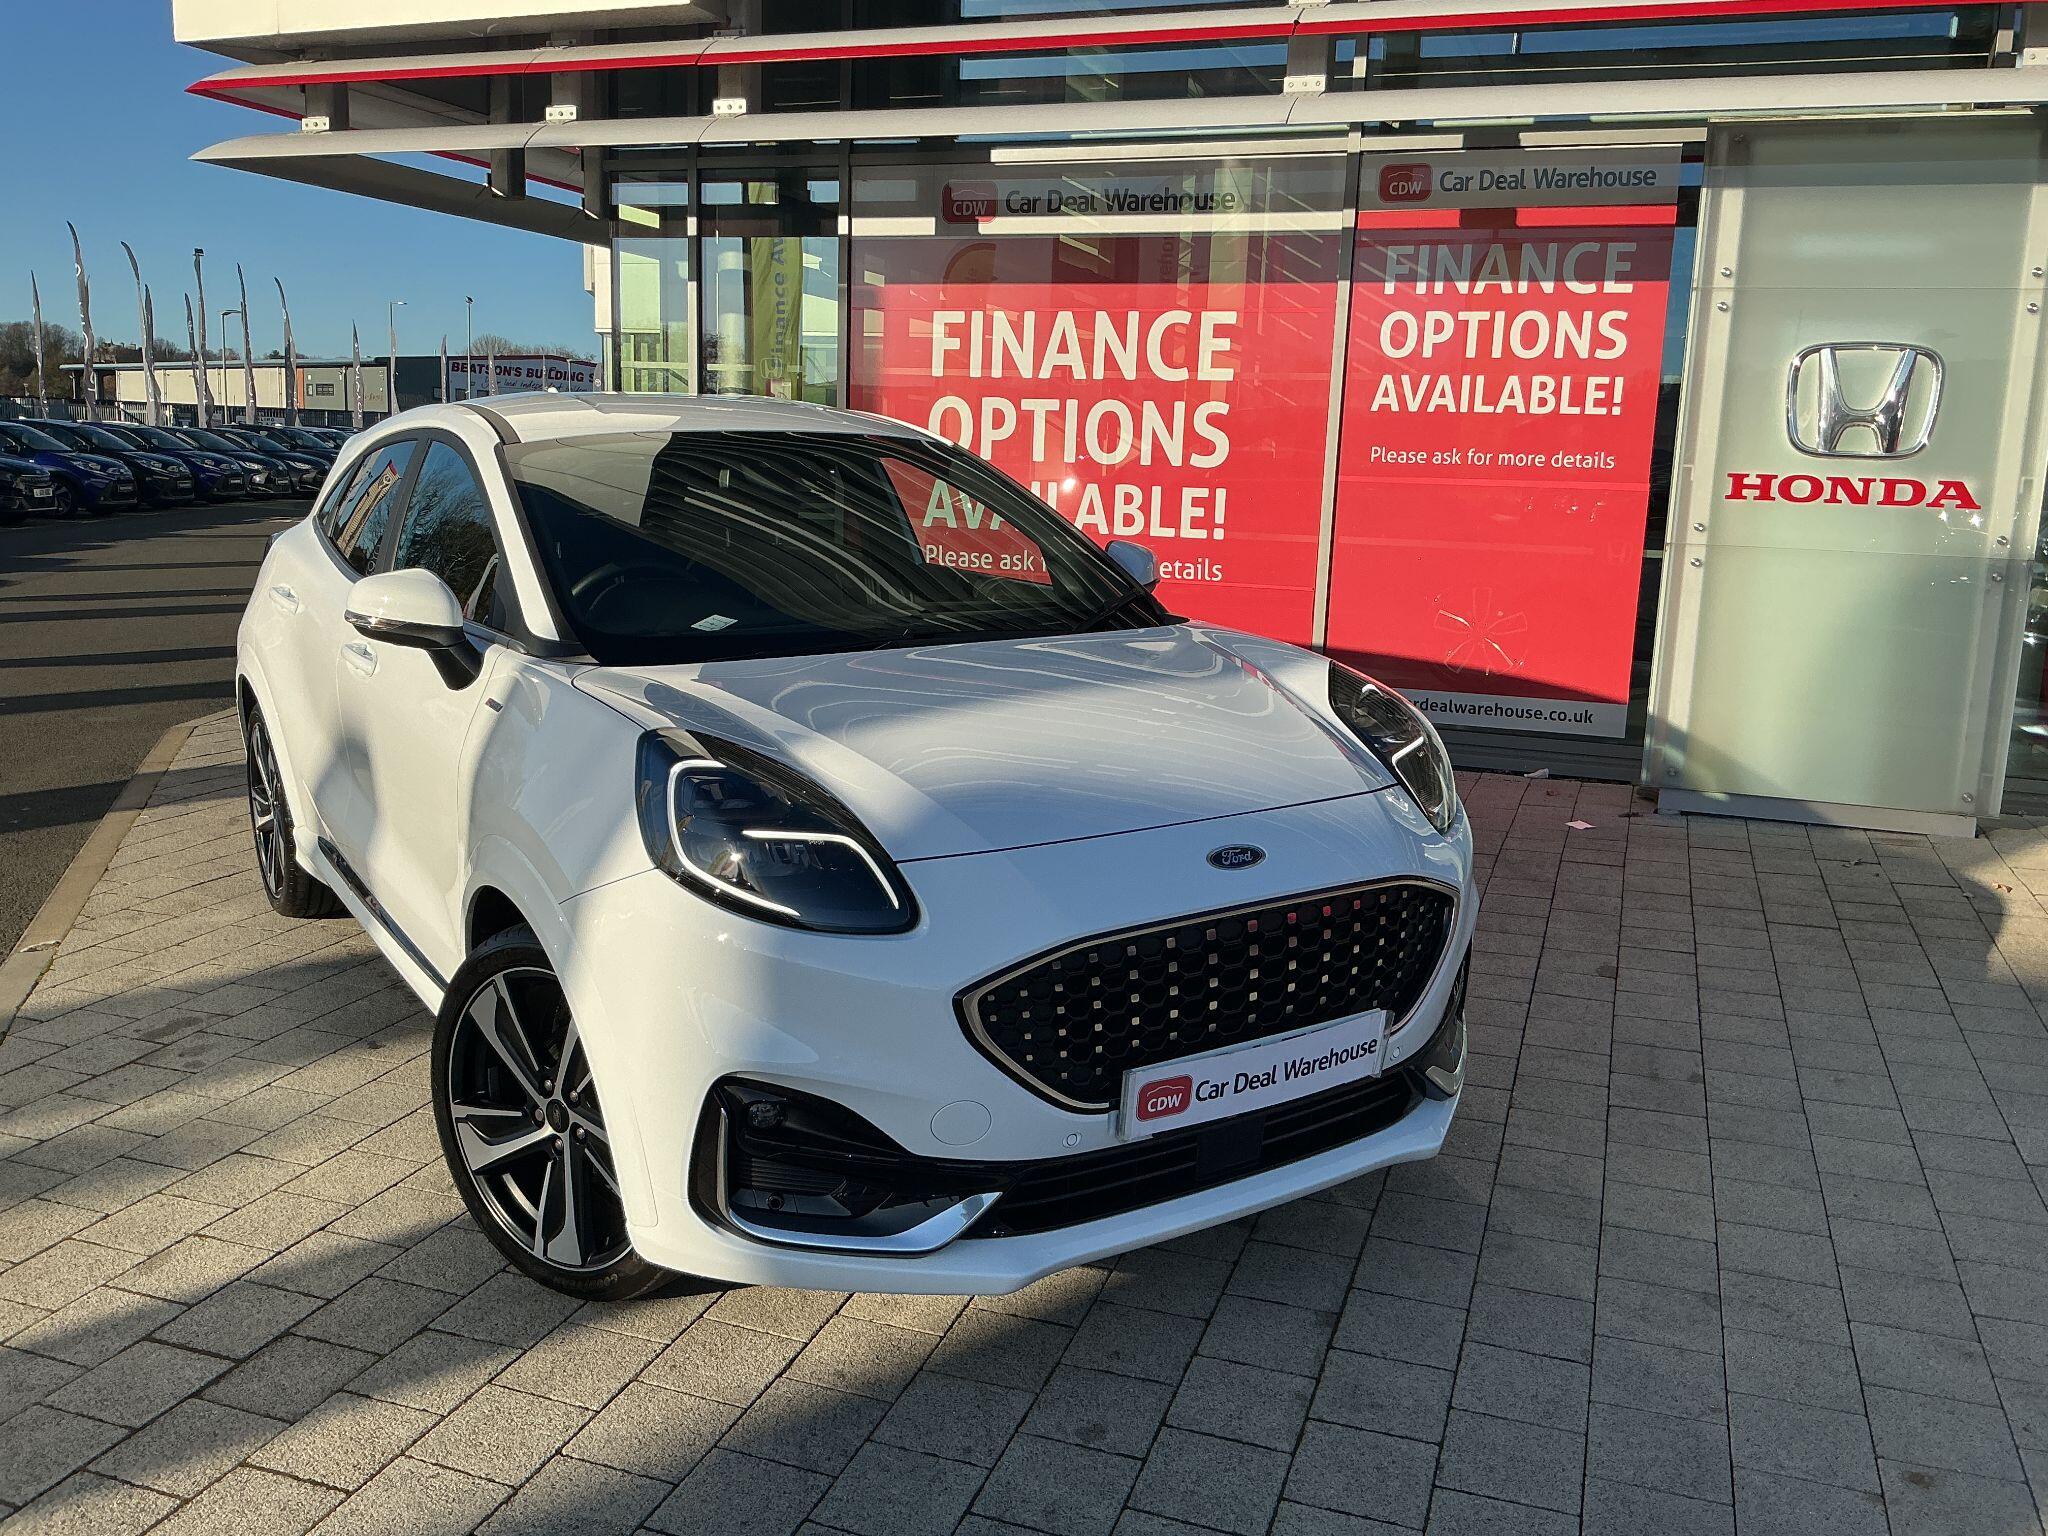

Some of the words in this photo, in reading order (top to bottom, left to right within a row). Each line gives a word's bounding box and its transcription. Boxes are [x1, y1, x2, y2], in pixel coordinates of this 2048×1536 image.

[952, 200, 988, 216] CDW
[1006, 190, 1039, 214] Car
[1046, 188, 1098, 213] Deal
[1103, 186, 1236, 213] Warehouse
[1389, 180, 1422, 196] CDW
[1440, 170, 1474, 193] Car
[1478, 168, 1527, 192] Deal
[1533, 166, 1657, 190] Warehouse
[1383, 241, 1637, 295] FINANCE
[931, 309, 1238, 382] FINANCE
[1379, 310, 1629, 360] OPTIONS
[1369, 374, 1625, 416] AVAILABLE!
[928, 394, 1231, 469] OPTIONS
[1370, 446, 1427, 466] Please
[1431, 447, 1462, 466] ask
[1466, 447, 1493, 466] for
[1498, 453, 1546, 468] more
[1550, 450, 1615, 469] details
[1725, 472, 1982, 510] HONDA
[926, 544, 993, 570] Please
[999, 549, 1036, 572] ask
[1159, 557, 1223, 582] etails
[1221, 848, 1254, 865] Ford
[1147, 1092, 1183, 1113] CDW
[1195, 1079, 1230, 1102] Car
[1233, 1064, 1278, 1095] Deal
[1282, 1037, 1379, 1082] Warehouse
